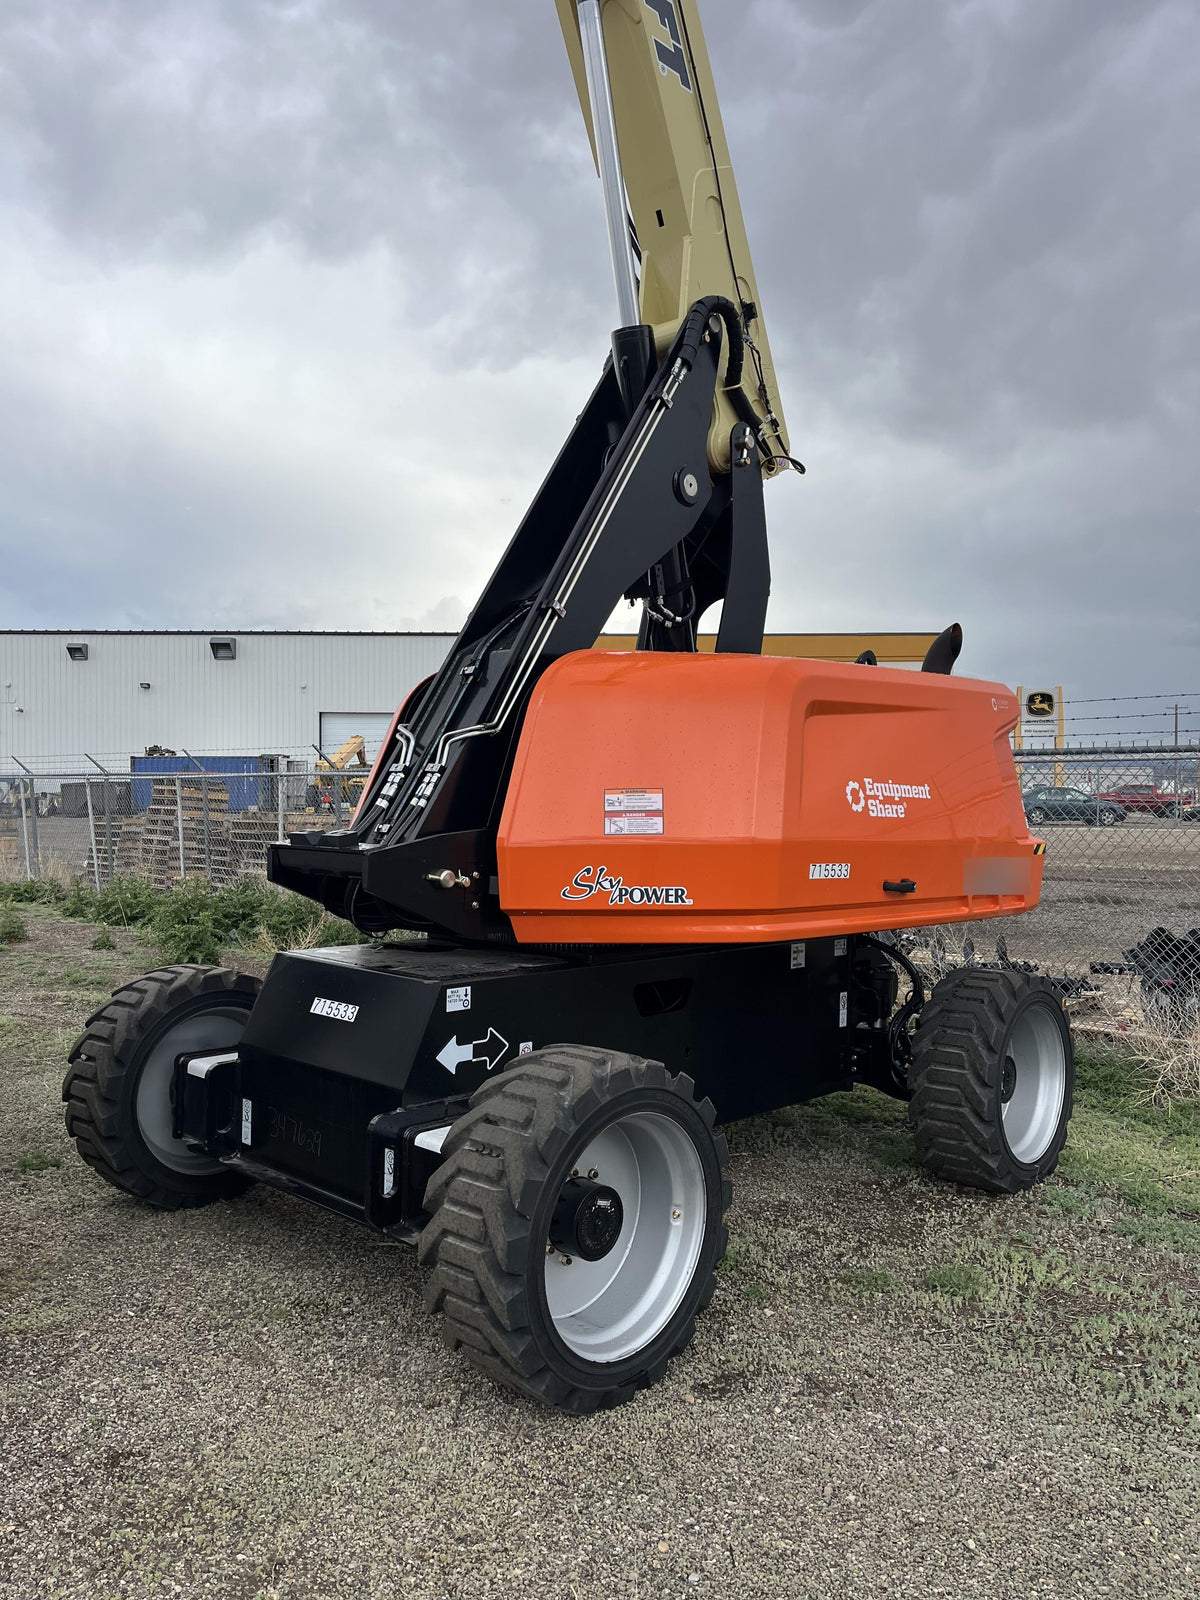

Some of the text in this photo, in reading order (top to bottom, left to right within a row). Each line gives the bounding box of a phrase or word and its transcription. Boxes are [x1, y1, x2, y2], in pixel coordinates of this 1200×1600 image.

[863, 778, 931, 800] Equipment
[811, 863, 850, 878] 715533
[312, 998, 358, 1021] 715533
